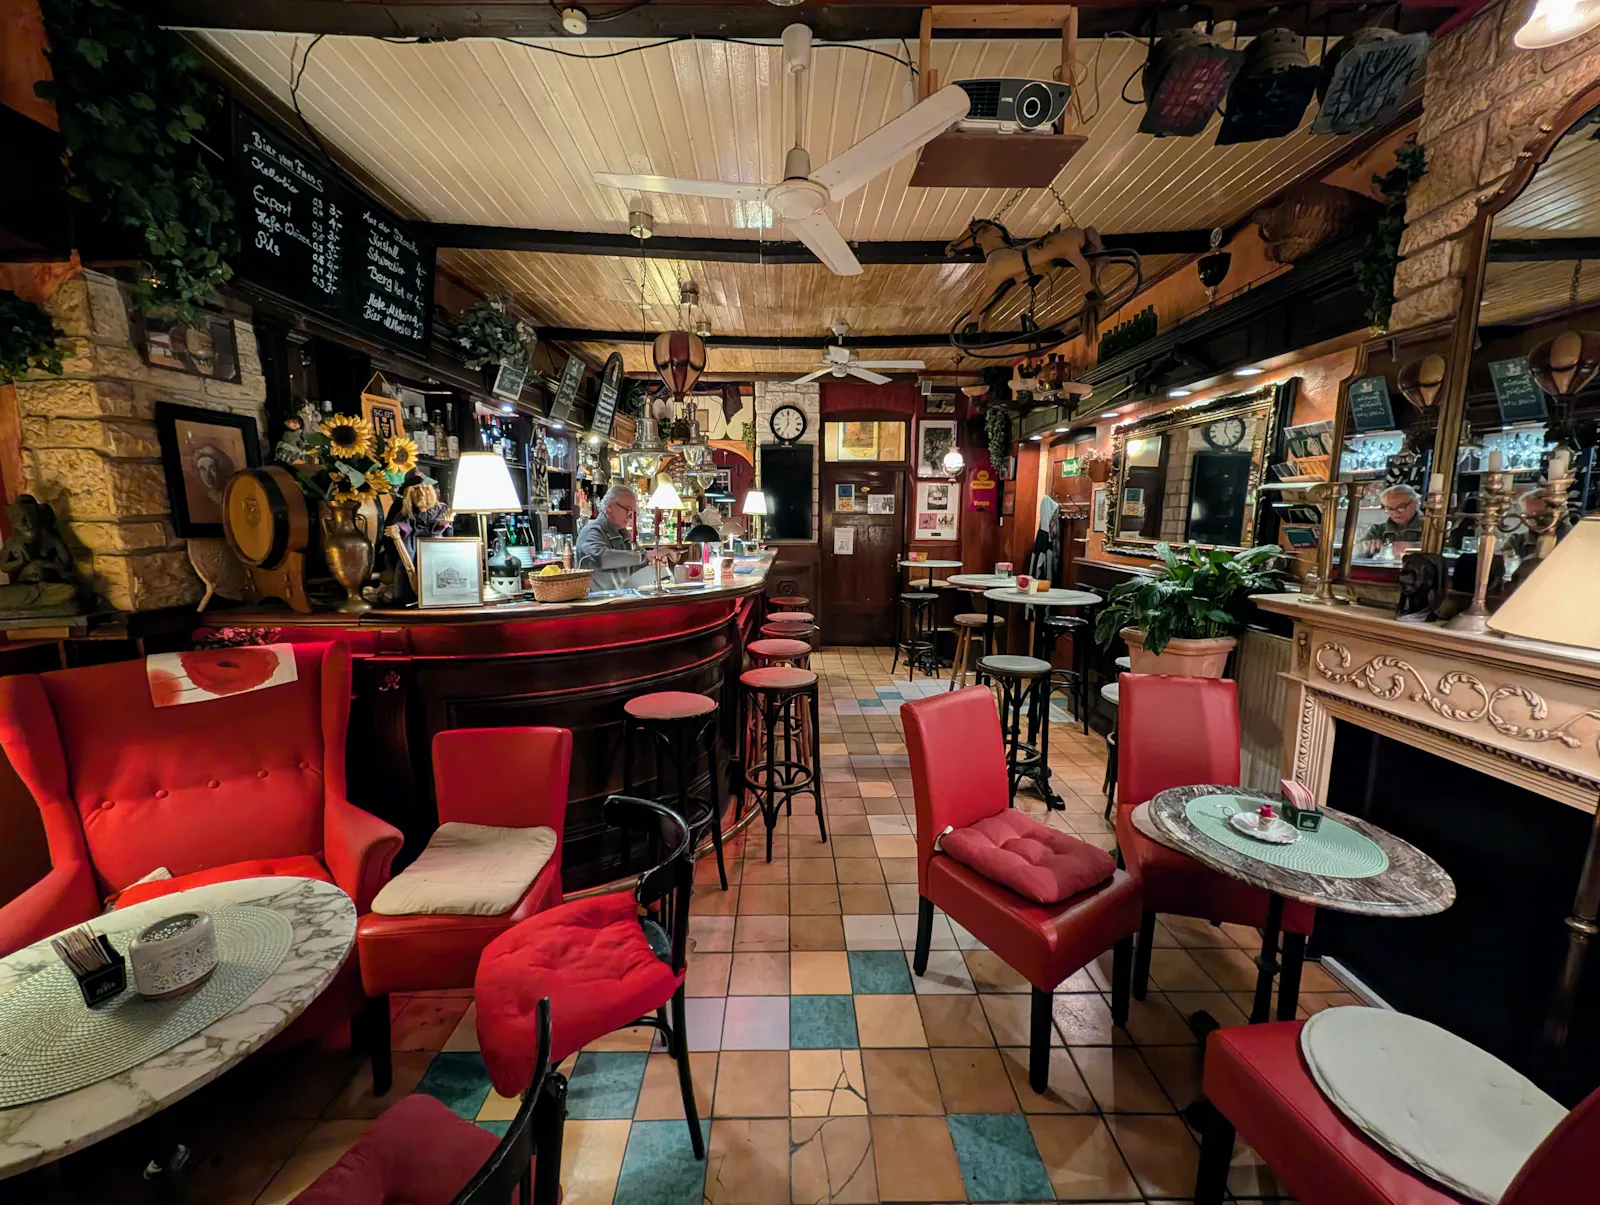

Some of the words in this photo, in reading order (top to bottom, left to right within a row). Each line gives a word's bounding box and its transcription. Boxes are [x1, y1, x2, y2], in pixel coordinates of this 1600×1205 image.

[251, 131, 277, 157] Bier
[253, 184, 292, 217] Export
[254, 230, 280, 256] Pils
[367, 265, 393, 292] Berg
